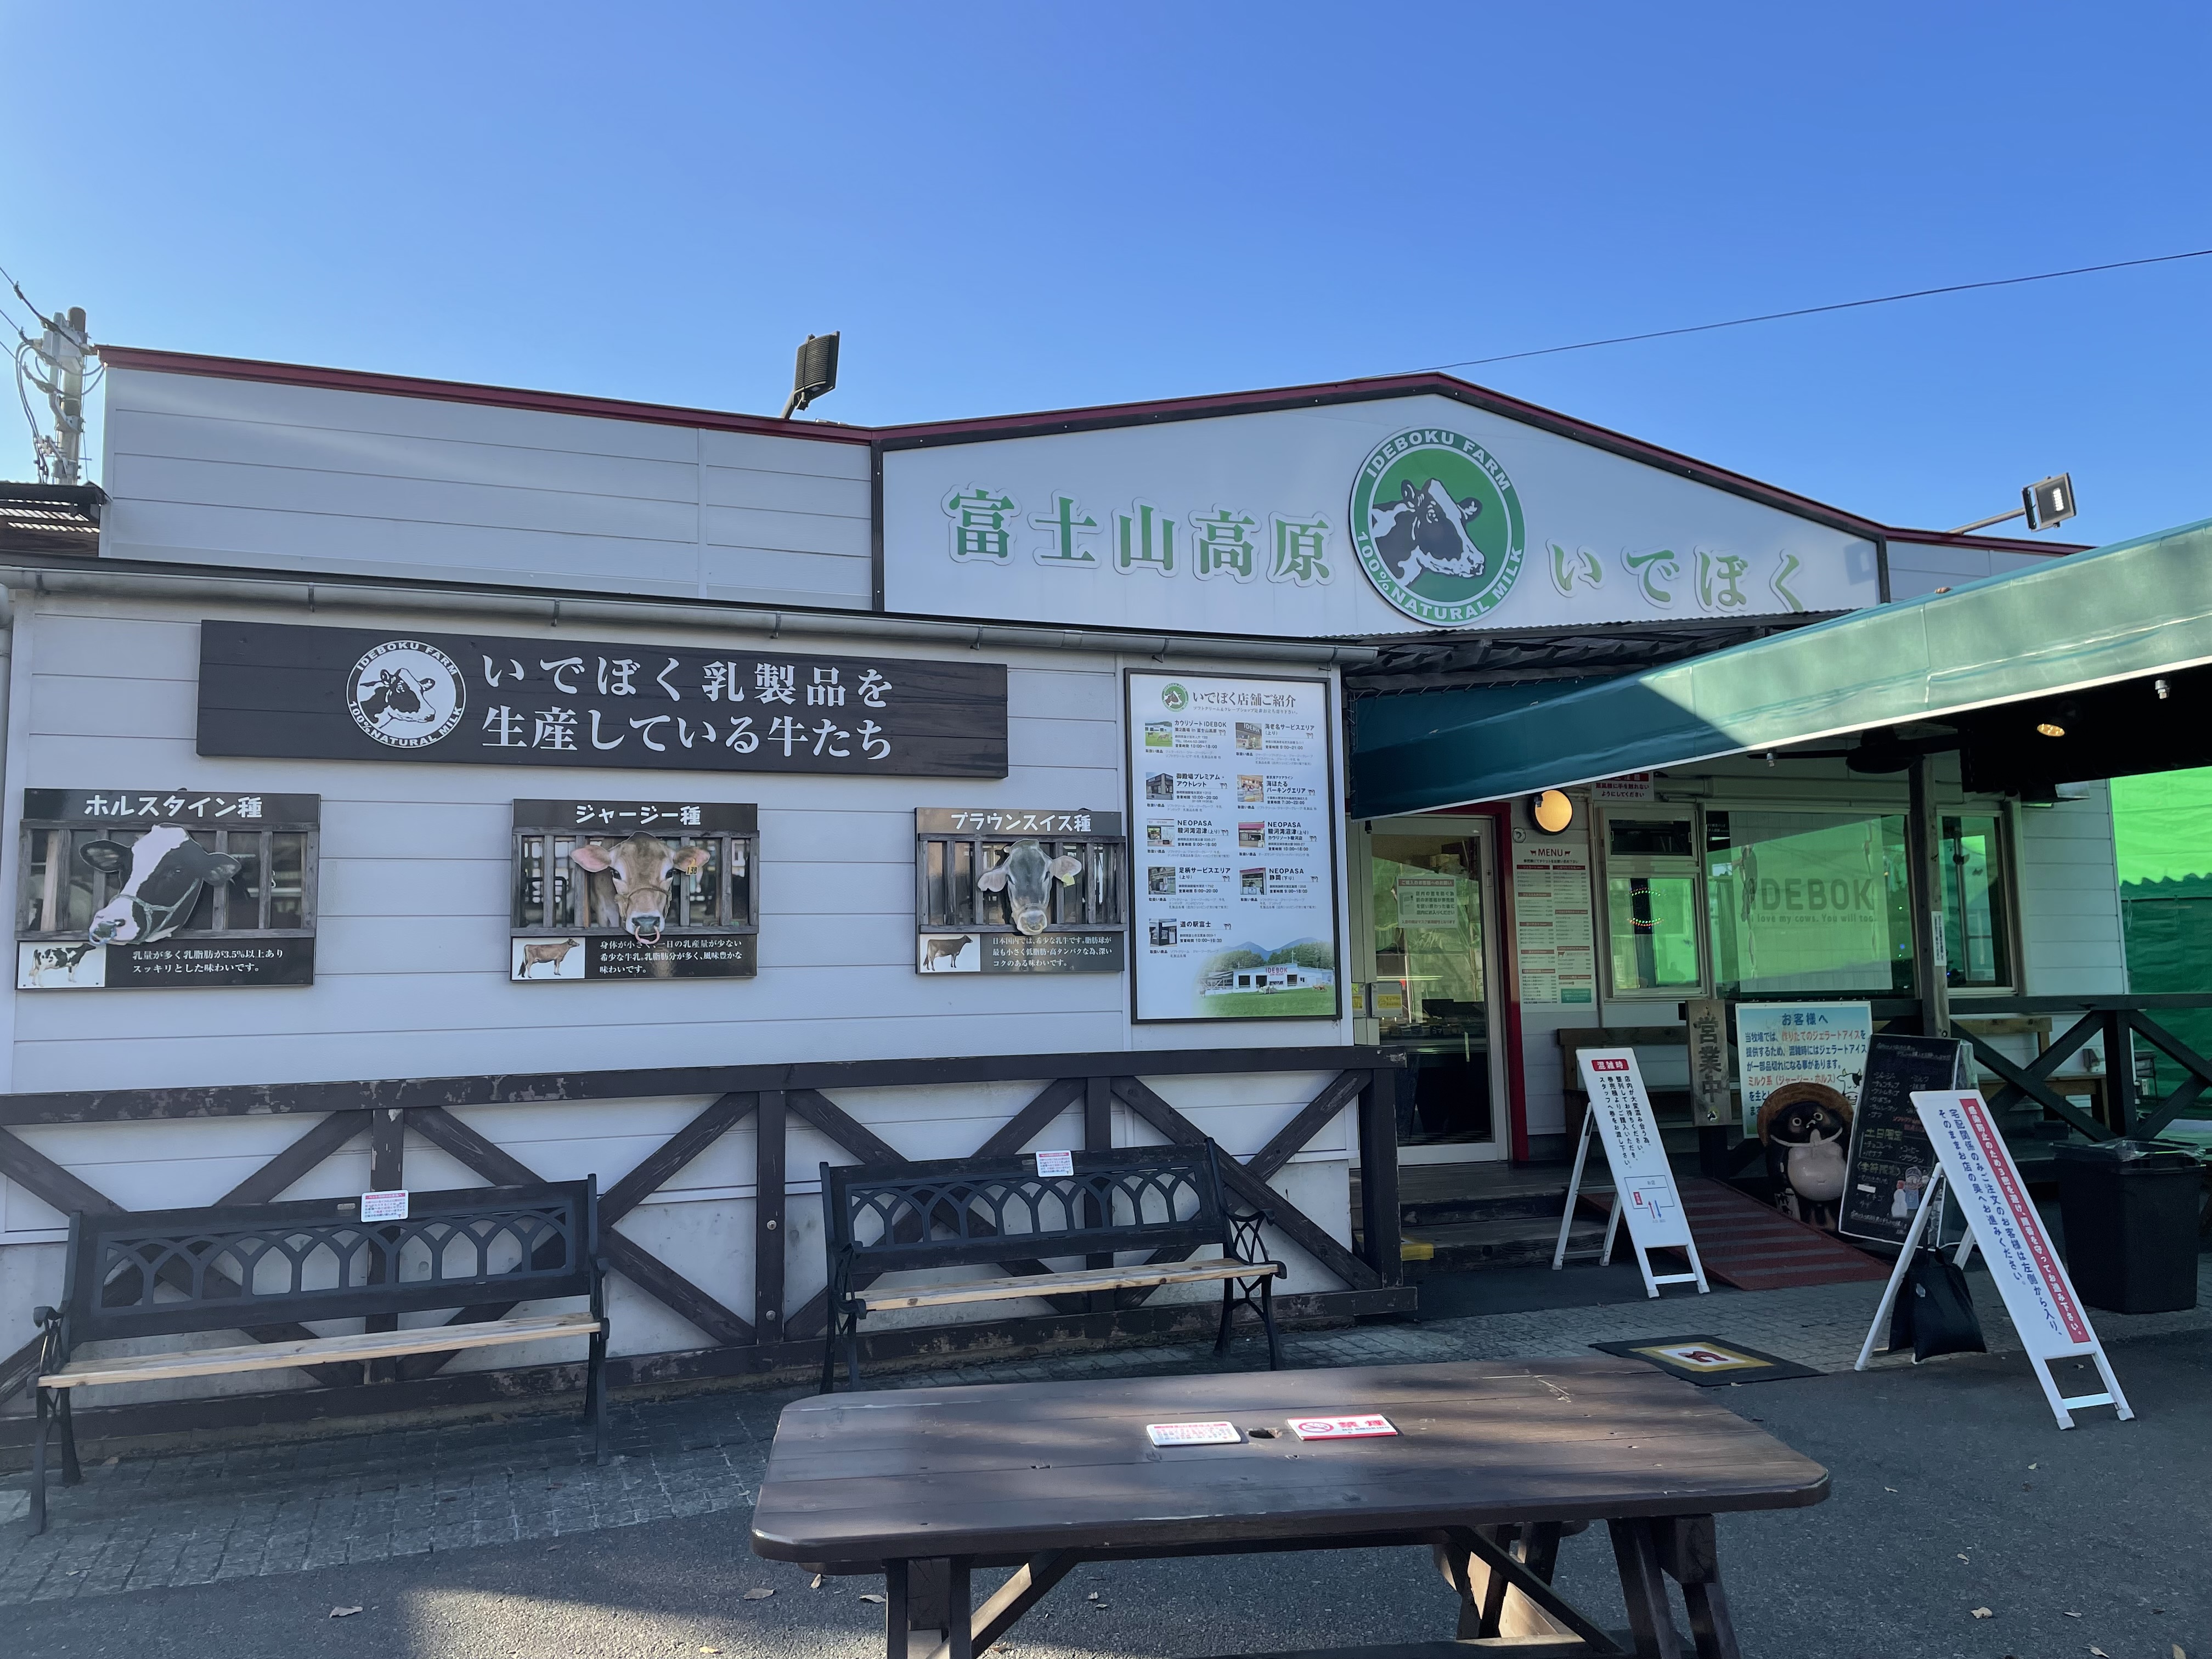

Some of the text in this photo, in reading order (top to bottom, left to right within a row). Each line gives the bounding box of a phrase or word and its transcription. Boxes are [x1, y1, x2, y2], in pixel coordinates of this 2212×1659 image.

[1366, 430, 1513, 492] IDEBOKU FARM
[949, 489, 1330, 580] 富士山高原
[1356, 531, 1523, 621] 100% NATURAL MILK
[1553, 543, 1803, 612] いでぼく
[356, 641, 457, 675] IDEBOKU FARM
[482, 654, 893, 708] いでぼく乳製品を
[1193, 691, 1296, 708] いでぼく店舗ご紹介
[350, 701, 463, 747] 100% NATURAL MILK
[482, 705, 891, 760] 生産している牛たち
[84, 794, 263, 818] ホルスタイン種
[575, 804, 701, 826] ジャージー種
[951, 812, 1092, 832] ブラウンスイス種
[1538, 849, 1563, 857] MENU
[1752, 878, 1875, 911] DEBOK
[1758, 914, 1776, 922] love
[1779, 915, 1792, 924] my
[1821, 914, 1838, 922] You
[1840, 914, 1857, 922] will
[132, 948, 283, 960] 乳量が多く乳脂肪が3.5%以上あり
[993, 959, 1067, 967] コクのある味わいです。
[132, 962, 260, 973] スッキリとした味わいです。
[600, 964, 647, 974] 味わいです。
[1782, 1013, 1829, 1025] お客様へ
[1745, 1030, 1866, 1043] 当牧場では、作りたてのジェラートアイスを
[1597, 1060, 1623, 1070] 混雑時
[1697, 1014, 1723, 1103] 営業中
[1747, 1059, 1841, 1072] が一部品切れになる事があります。
